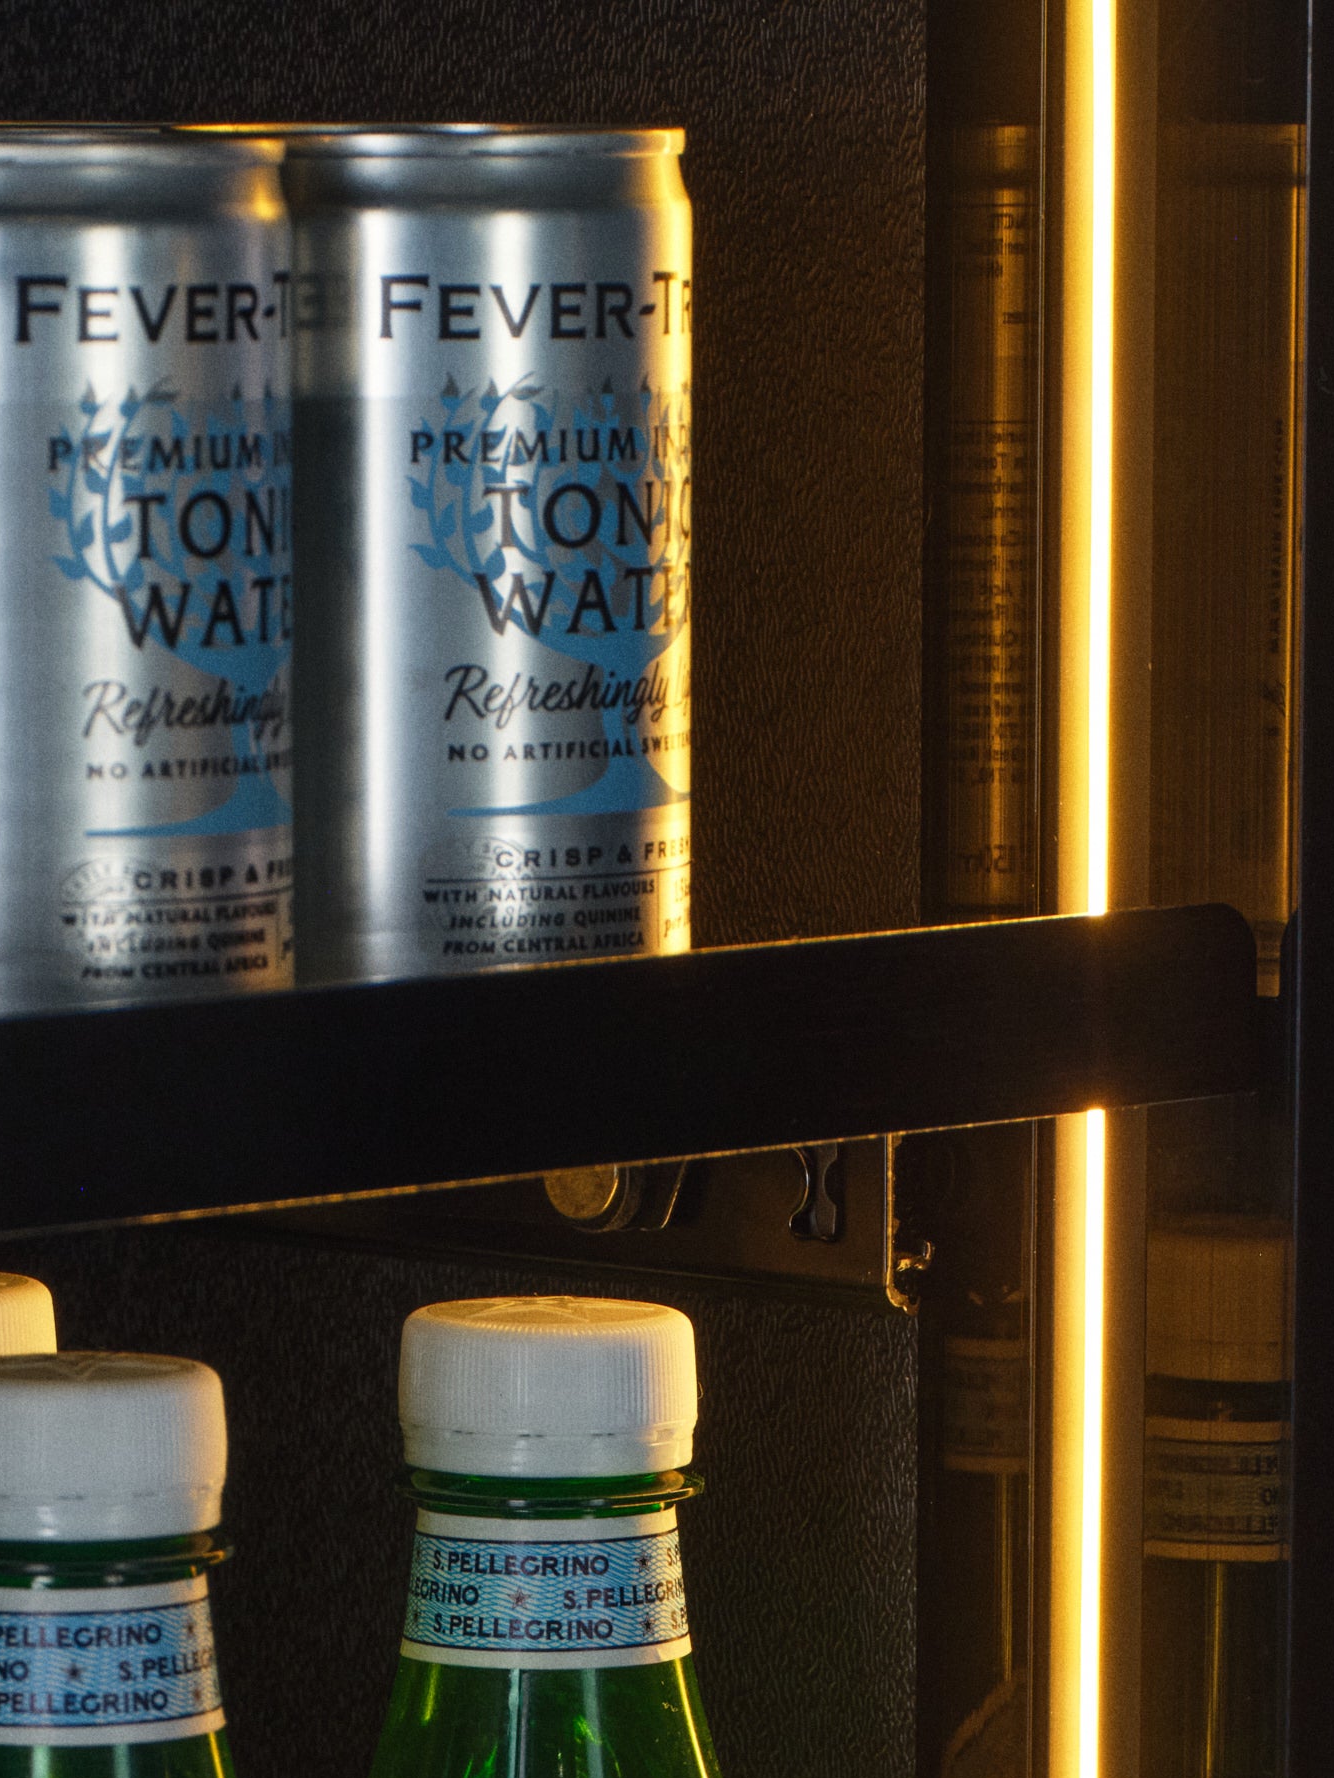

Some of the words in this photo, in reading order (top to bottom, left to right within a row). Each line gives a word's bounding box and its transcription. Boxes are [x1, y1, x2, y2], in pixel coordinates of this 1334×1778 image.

[46, 434, 265, 475] PREMIUM
[409, 424, 639, 466] PREMIUM
[481, 475, 691, 551] TONIC
[443, 659, 670, 730] Refreshingly
[447, 742, 490, 762] NO
[503, 731, 635, 762] ARTIFICIAL
[86, 761, 128, 781] NO
[140, 751, 260, 781] ARTIFICIAL
[494, 842, 605, 870] CRISP
[616, 842, 633, 864] &
[133, 865, 235, 891] CRISP
[422, 889, 478, 906] WITH
[489, 884, 579, 905] NATURAL
[582, 878, 656, 900] FLAVOURS
[449, 911, 566, 931] INCLUDING
[573, 905, 642, 927] QUININE
[441, 938, 497, 957] FROM
[503, 935, 589, 954] CENTRAL
[593, 931, 646, 951] AFRICA
[432, 1549, 610, 1577] S.PELLEGRINO
[433, 1611, 614, 1642] S.PELLEGRINO
